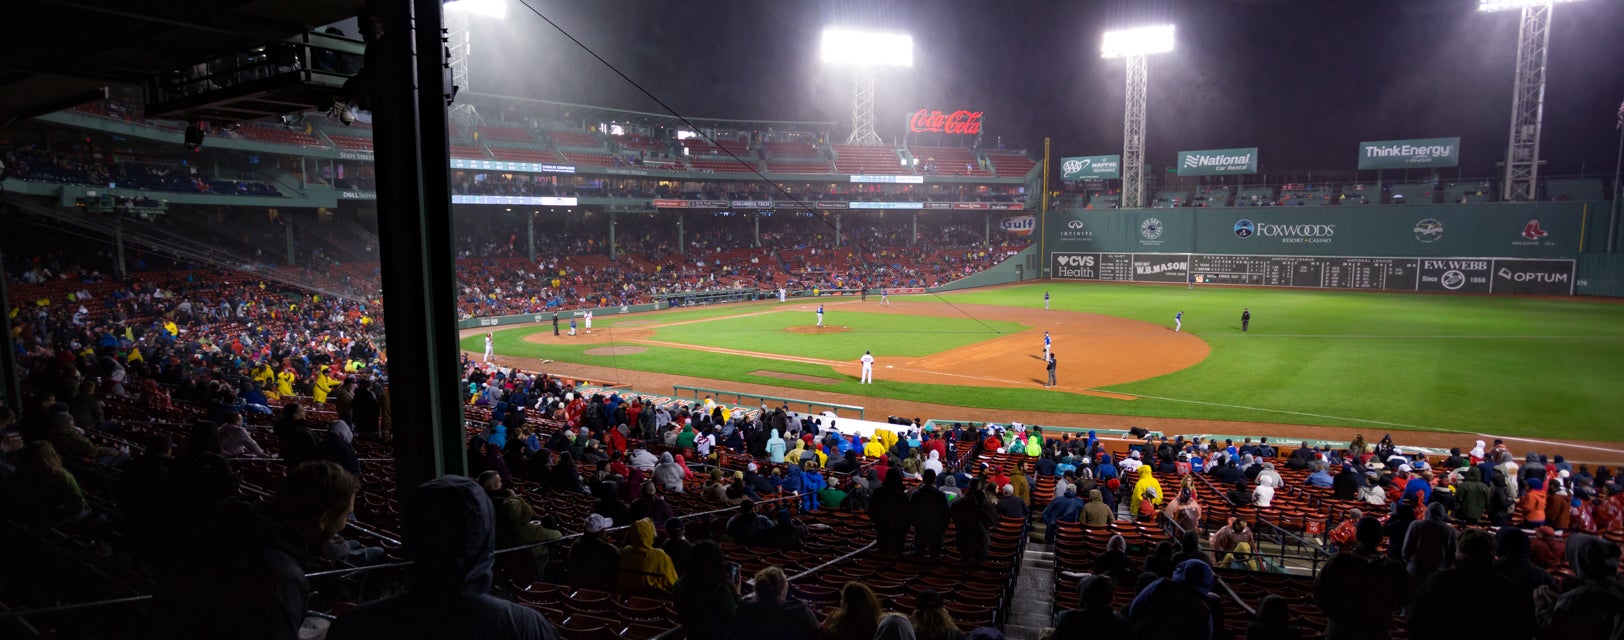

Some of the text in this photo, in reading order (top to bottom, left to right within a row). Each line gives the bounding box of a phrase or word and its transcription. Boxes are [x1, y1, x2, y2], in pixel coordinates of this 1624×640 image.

[910, 109, 983, 134] Coca-Cola
[1365, 145, 1450, 157] ThinkEnergy
[1198, 153, 1251, 166] National
[1002, 219, 1034, 229] Gulf
[1256, 222, 1335, 237] FOXWOODS
[1069, 255, 1095, 267] CVS
[1424, 260, 1447, 269] F.W.
[1448, 261, 1488, 270] WEBB
[1058, 266, 1095, 278] Health
[1513, 272, 1568, 283] OPTUM
[697, 436, 709, 444] 27
